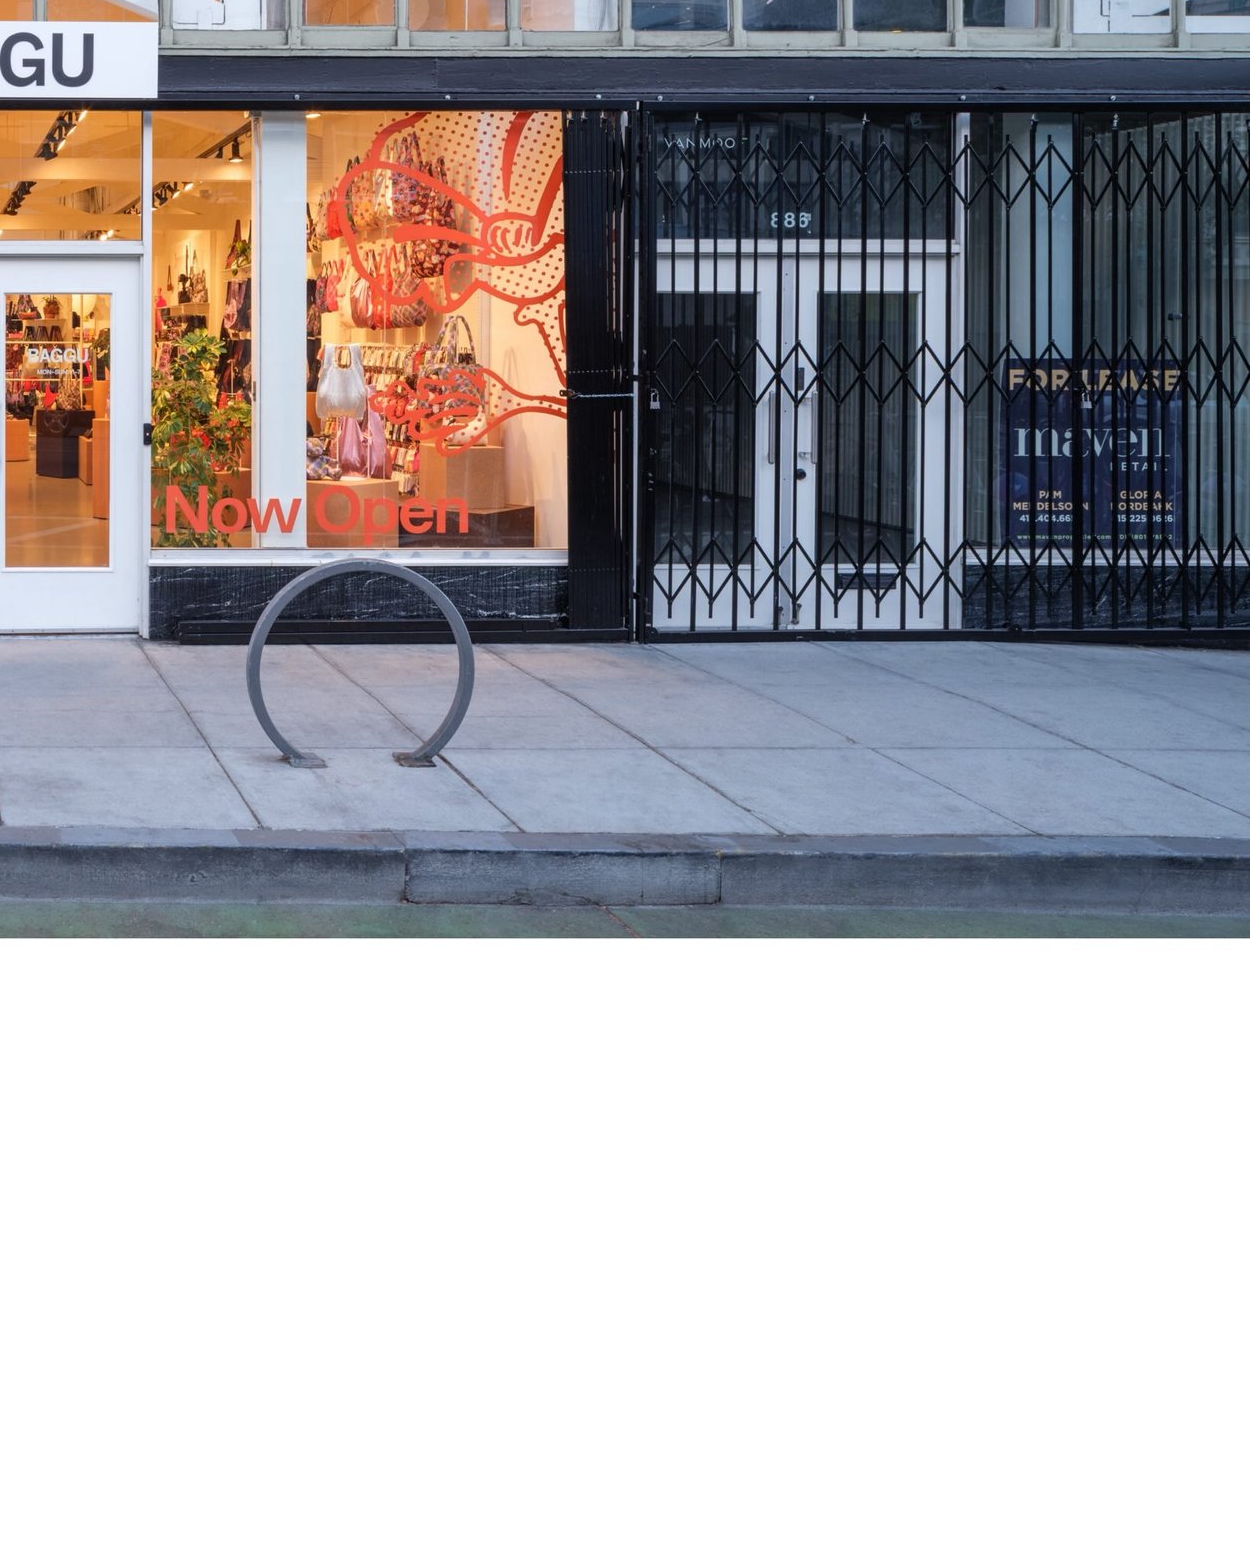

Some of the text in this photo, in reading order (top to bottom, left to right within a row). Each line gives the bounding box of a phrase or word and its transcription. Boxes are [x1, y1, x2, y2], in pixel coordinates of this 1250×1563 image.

[27, 348, 89, 363] BAGGU
[1009, 369, 1181, 391] FOR LEASE
[1014, 427, 1171, 458] maven
[165, 484, 469, 546] Now Open
[1013, 502, 1089, 511] MEDELSON
